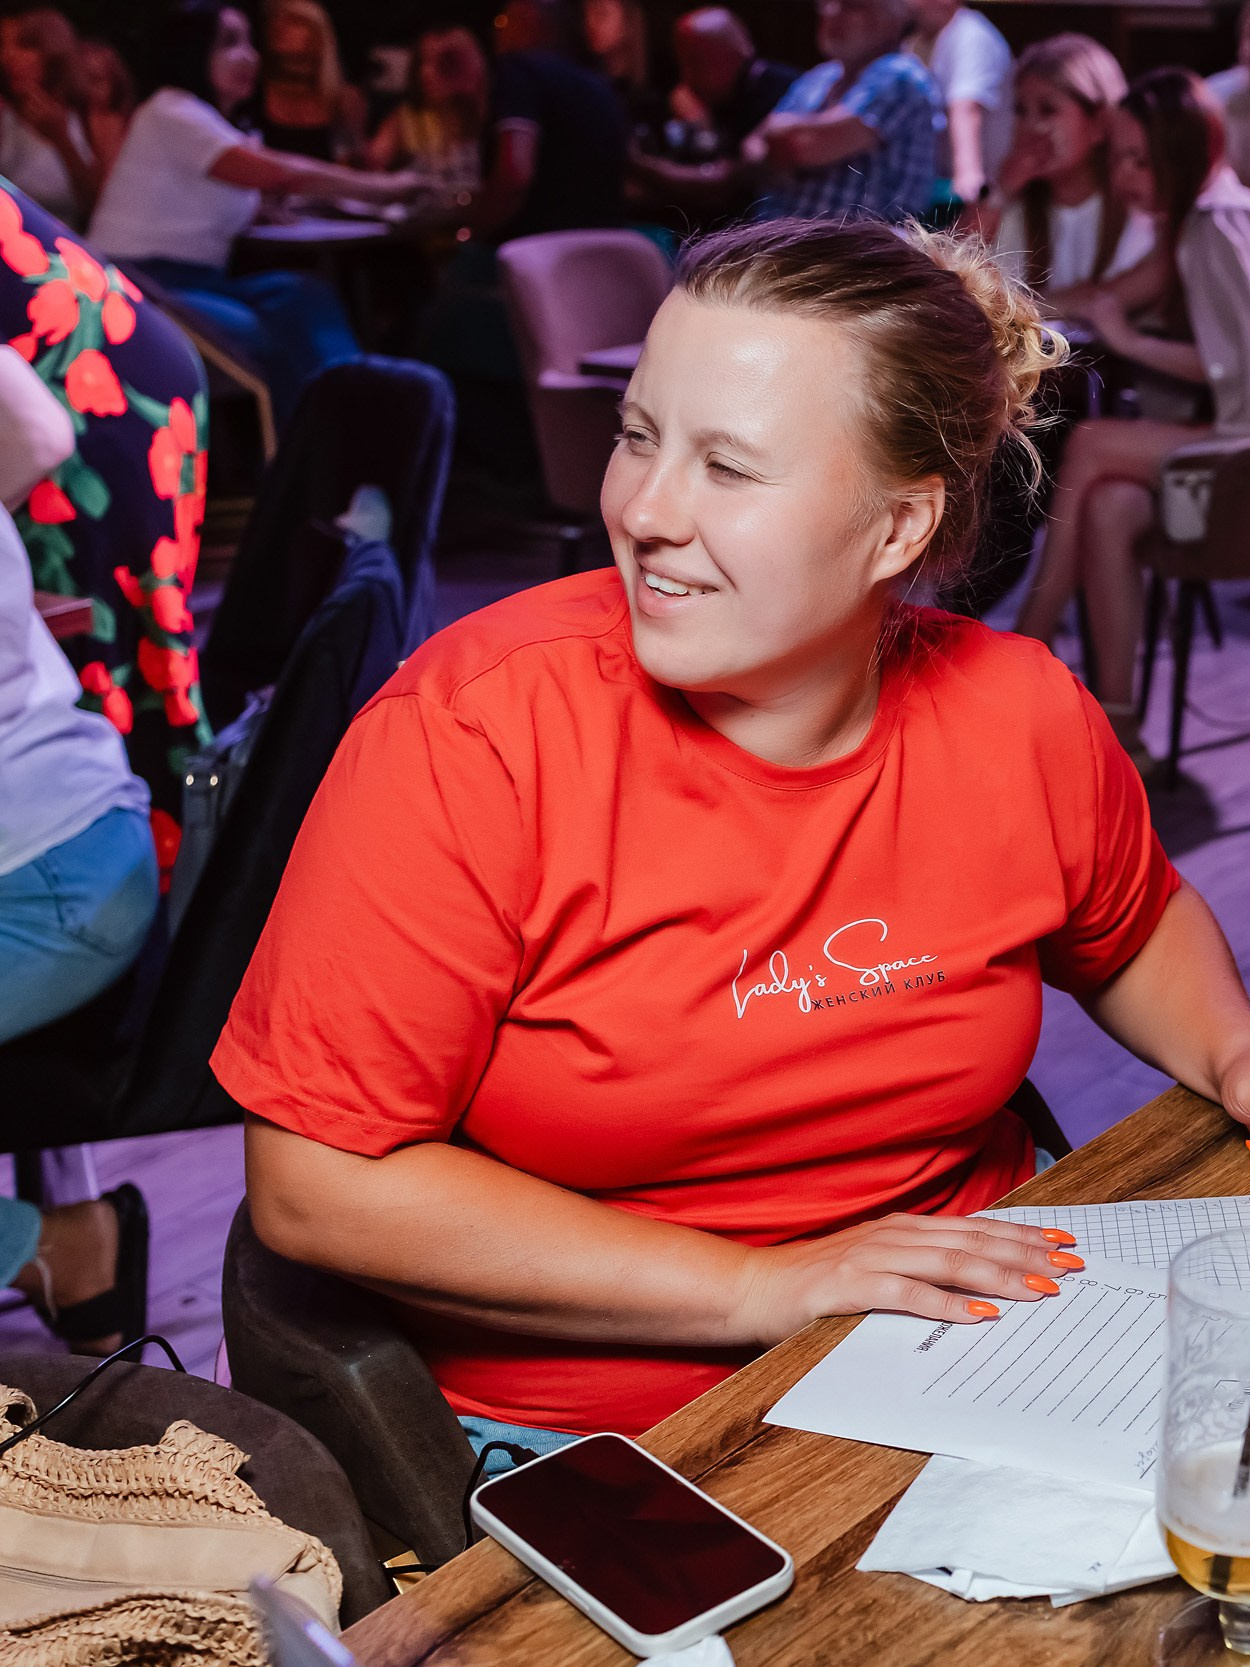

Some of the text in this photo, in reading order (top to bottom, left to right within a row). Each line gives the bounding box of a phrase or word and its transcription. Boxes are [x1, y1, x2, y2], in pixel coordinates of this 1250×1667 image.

[731, 918, 938, 1019] Lady's Space
[811, 970, 947, 1011] ЖЕНСКИЙ КЛУБ
[913, 1322, 953, 1354] ОЖЕЛАНИЯ:
